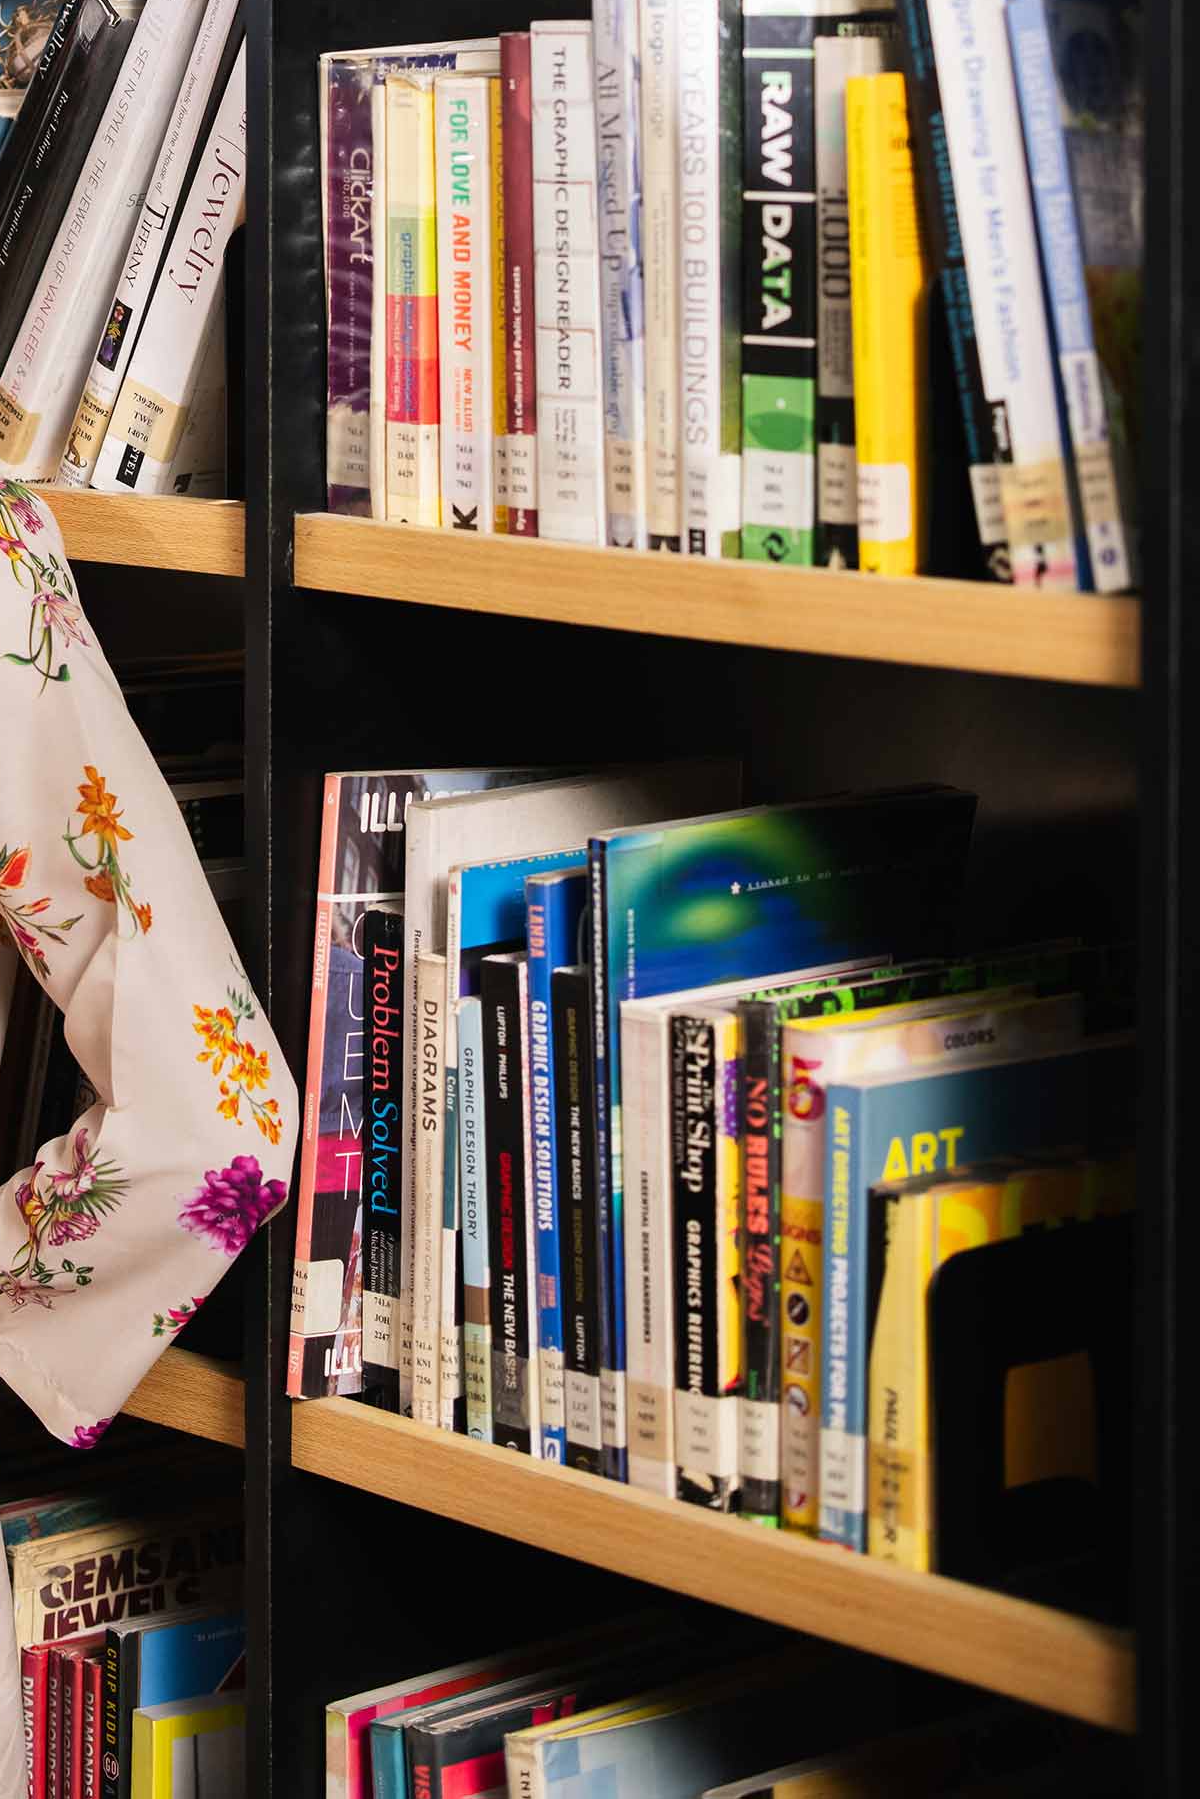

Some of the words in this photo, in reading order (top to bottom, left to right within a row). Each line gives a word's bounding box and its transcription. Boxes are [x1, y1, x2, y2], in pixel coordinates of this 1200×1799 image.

[124, 77, 137, 100] IN
[133, 46, 149, 80] SET
[552, 48, 567, 89] THE
[595, 60, 618, 100] All
[103, 100, 130, 149] STYLE
[449, 99, 470, 142] FOR
[683, 66, 707, 176] YEARS
[761, 71, 793, 187] RAW
[86, 157, 107, 190] THE
[553, 99, 569, 199] GRAPHIC
[597, 111, 625, 216] Messed
[348, 146, 374, 265] ClickArt
[450, 152, 472, 206] LOVE
[3, 184, 33, 255] Exceptional
[63, 193, 93, 259] JEWELRY
[125, 200, 170, 288] TIFFANY
[167, 147, 241, 304] Jewelry
[452, 214, 471, 262] AND
[683, 188, 707, 245] 100
[49, 259, 67, 285] OF
[555, 209, 570, 295] DESIGN
[761, 204, 793, 330] DATA
[39, 281, 60, 318] VAN
[453, 269, 473, 351] MONEY
[23, 314, 46, 367] CLEEF
[556, 301, 572, 390] READER
[684, 259, 709, 446] BUILDINGS
[133, 391, 164, 415] 739.2709
[463, 367, 473, 395] NEW
[529, 904, 544, 958] LANDA
[372, 944, 400, 1091] Problem
[496, 1005, 507, 1047] LUPTON
[531, 1000, 549, 1072] GRAPHIC
[943, 1027, 996, 1051] COLORS
[422, 999, 438, 1131] DIAGRAMS
[463, 1047, 475, 1114] GRAPHIC
[497, 1053, 509, 1099] PHILLIPS
[686, 1043, 711, 1112] Print
[446, 1075, 456, 1112] Color
[533, 1075, 550, 1138] DESIGN
[570, 1105, 581, 1128] THE
[744, 1076, 768, 1128] NO
[464, 1119, 476, 1175] DESIGN
[571, 1130, 581, 1157] NEW
[834, 1105, 850, 1146] ART
[369, 1097, 398, 1215] Solved
[571, 1158, 582, 1200] BASICS
[680, 1119, 712, 1193] Shop
[881, 1126, 965, 1181] ART
[465, 1180, 478, 1240] THEORY
[535, 1139, 553, 1231] SOLUTIONS
[746, 1134, 769, 1235] RULES
[502, 1273, 515, 1302] THE
[686, 1219, 700, 1307] GRAPHICS
[503, 1303, 516, 1337] NEW
[575, 1315, 585, 1360] LUPTON
[105, 1648, 117, 1693] CHIP
[83, 1690, 95, 1797] DIAMONDS
[104, 1700, 116, 1745] KIDD
